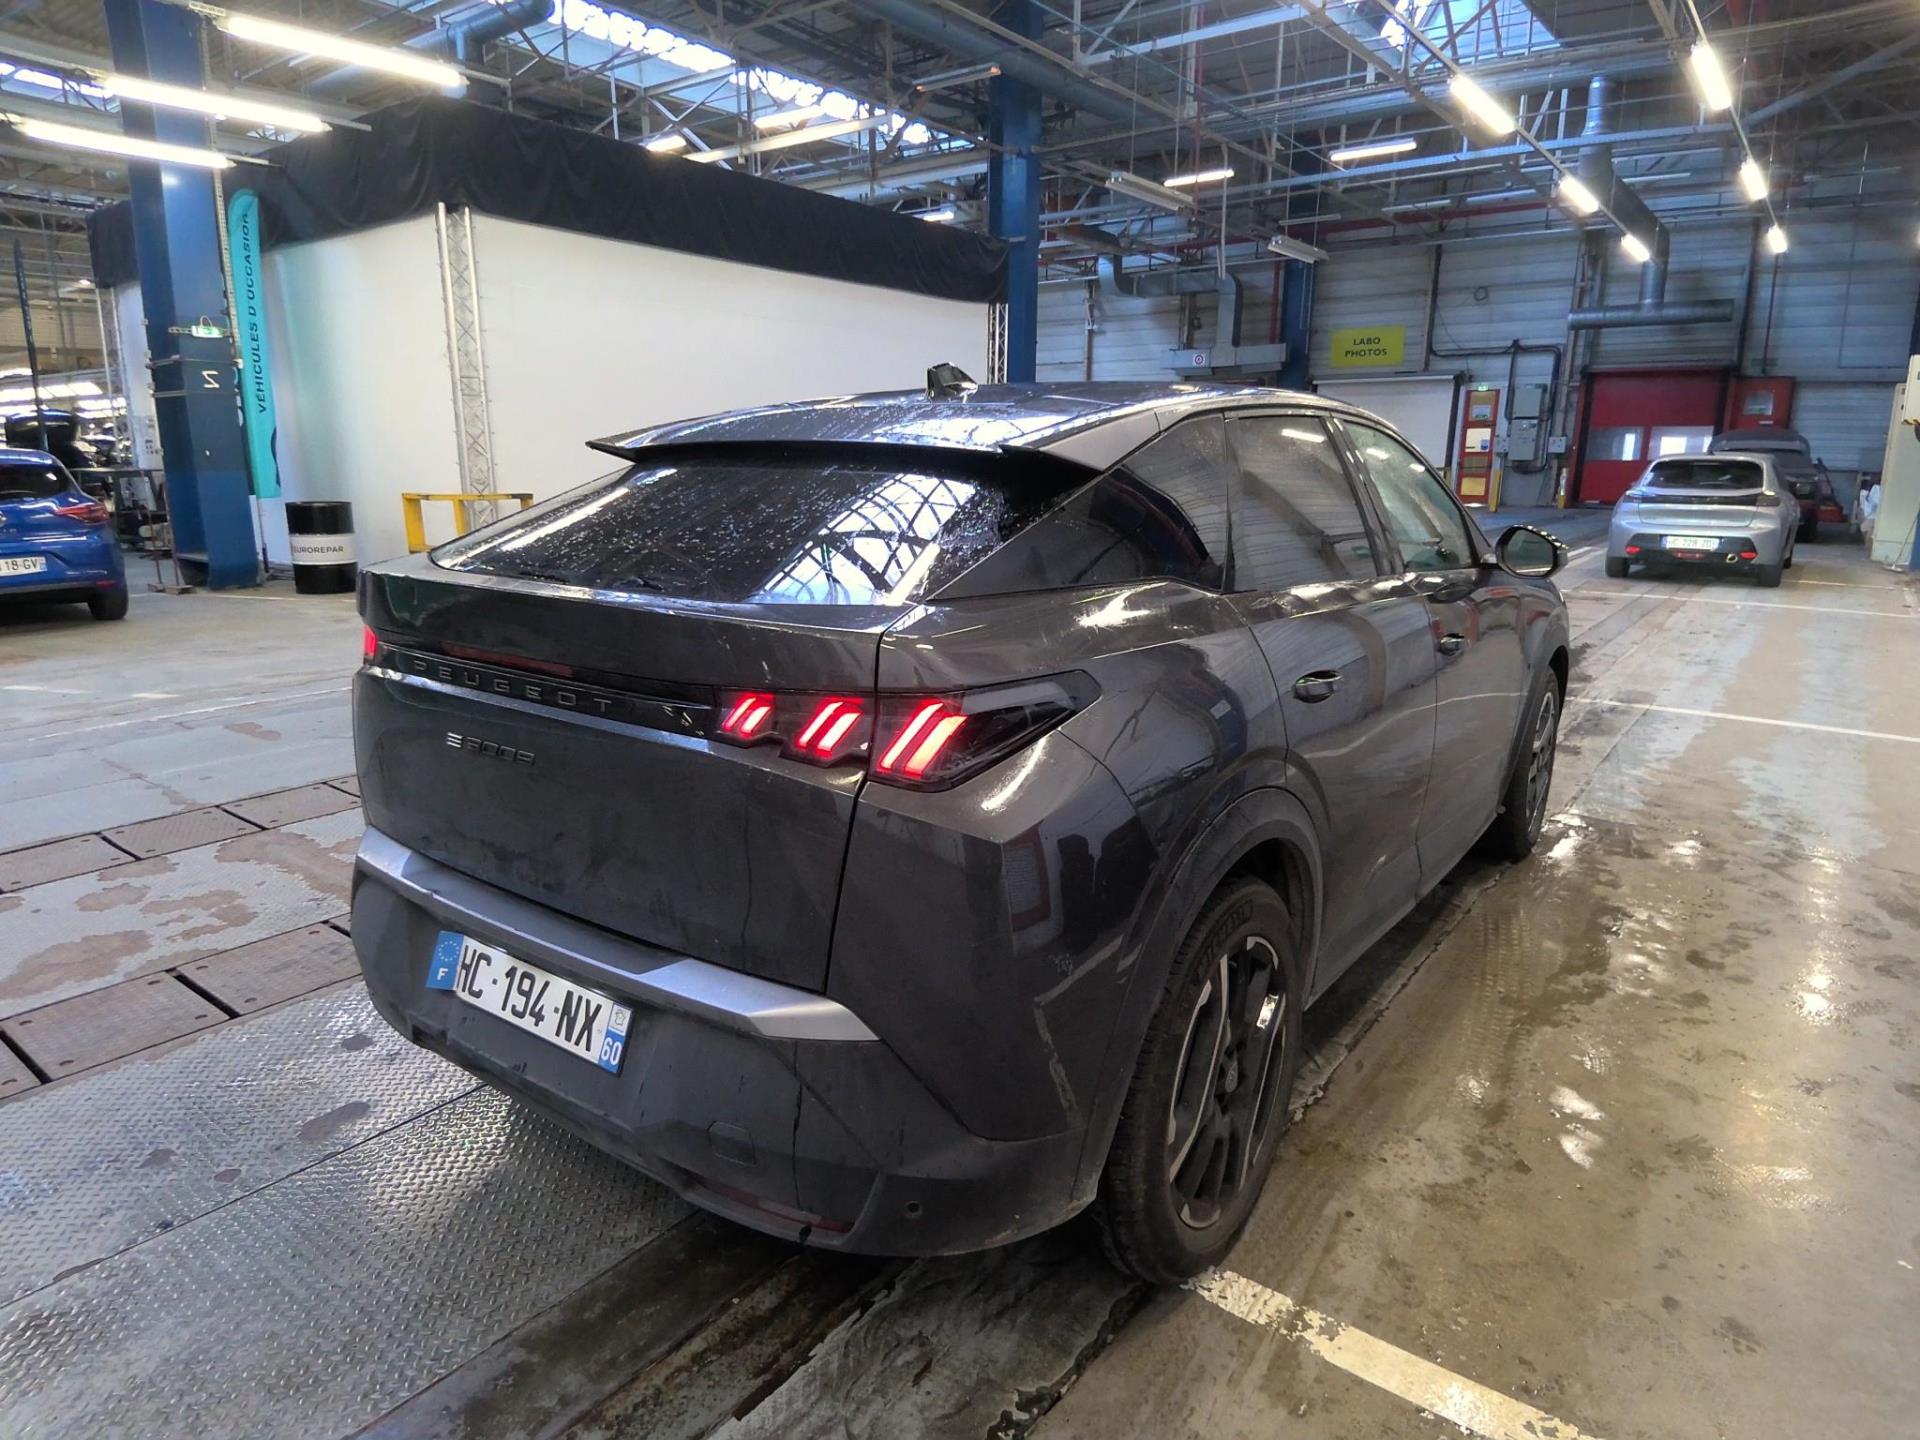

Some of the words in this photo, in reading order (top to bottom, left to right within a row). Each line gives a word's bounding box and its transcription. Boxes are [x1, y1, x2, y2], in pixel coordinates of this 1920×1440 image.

[1353, 336, 1381, 346] LABO
[1344, 348, 1388, 358] PHOTOS
[413, 659, 612, 713] PEUGEOT
[436, 967, 449, 981] F
[601, 1036, 623, 1066] 60
